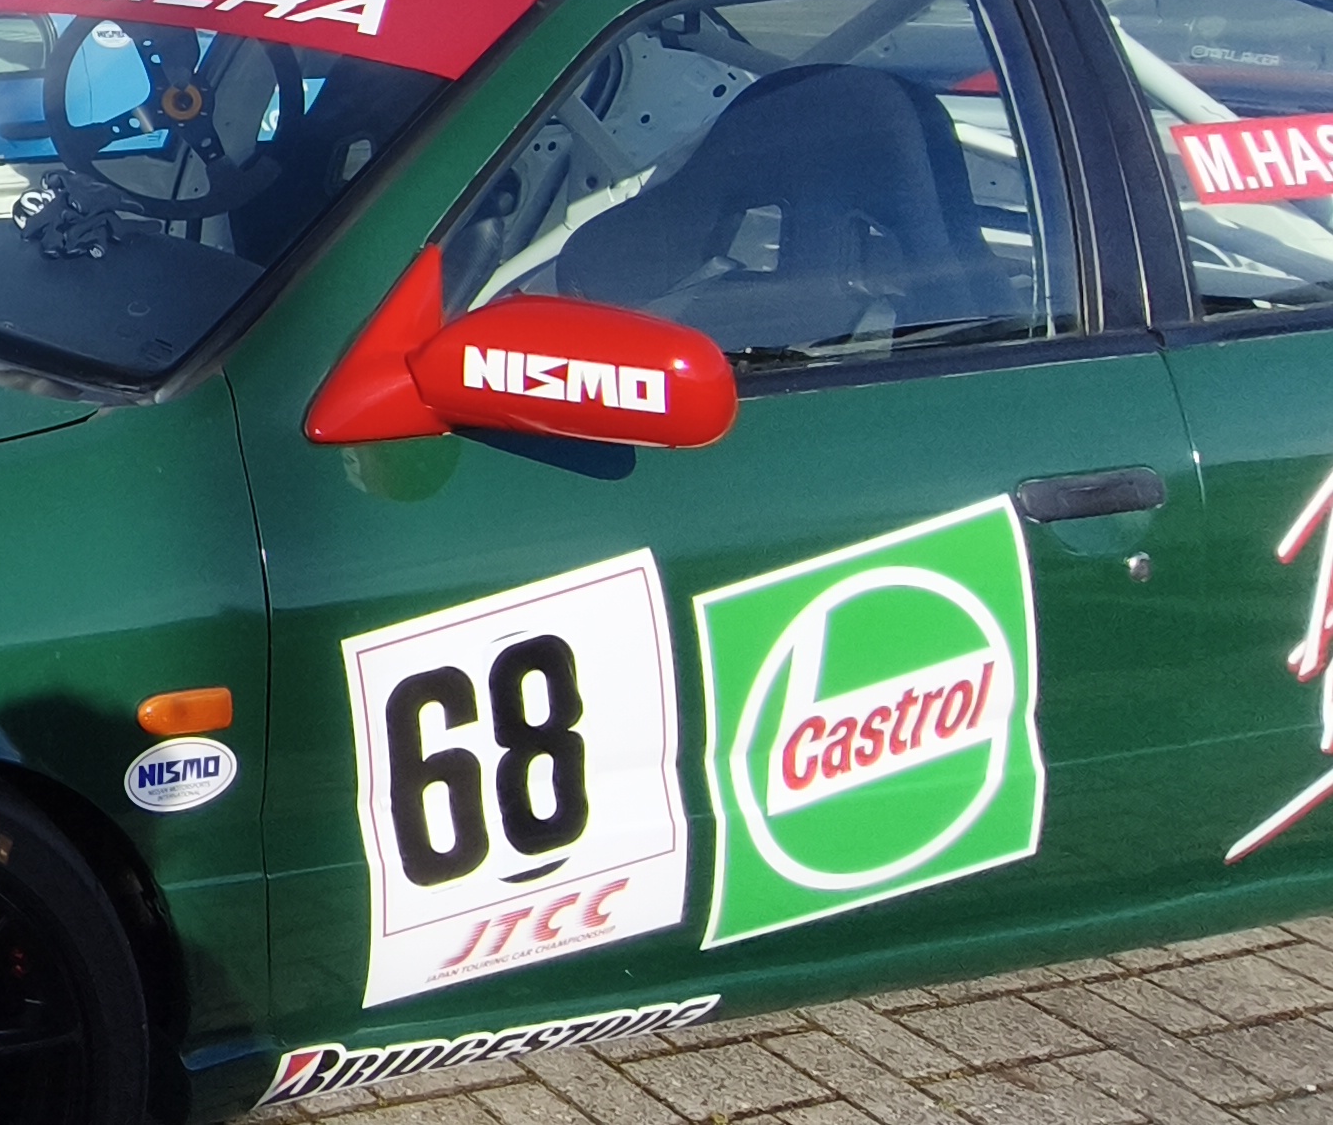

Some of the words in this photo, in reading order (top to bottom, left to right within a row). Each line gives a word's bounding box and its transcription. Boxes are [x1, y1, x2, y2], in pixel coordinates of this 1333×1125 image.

[463, 344, 667, 414] NISMO
[138, 755, 221, 789] NISMO
[385, 633, 590, 888] 68
[782, 660, 996, 792] Castrol
[424, 967, 460, 984] JAPAN
[461, 952, 509, 974] TOURING
[511, 947, 534, 962] CAR
[535, 925, 617, 955] CHAMPIONSHIP
[438, 877, 630, 970] JTCC
[258, 994, 713, 1107] BRIDGESTONE
